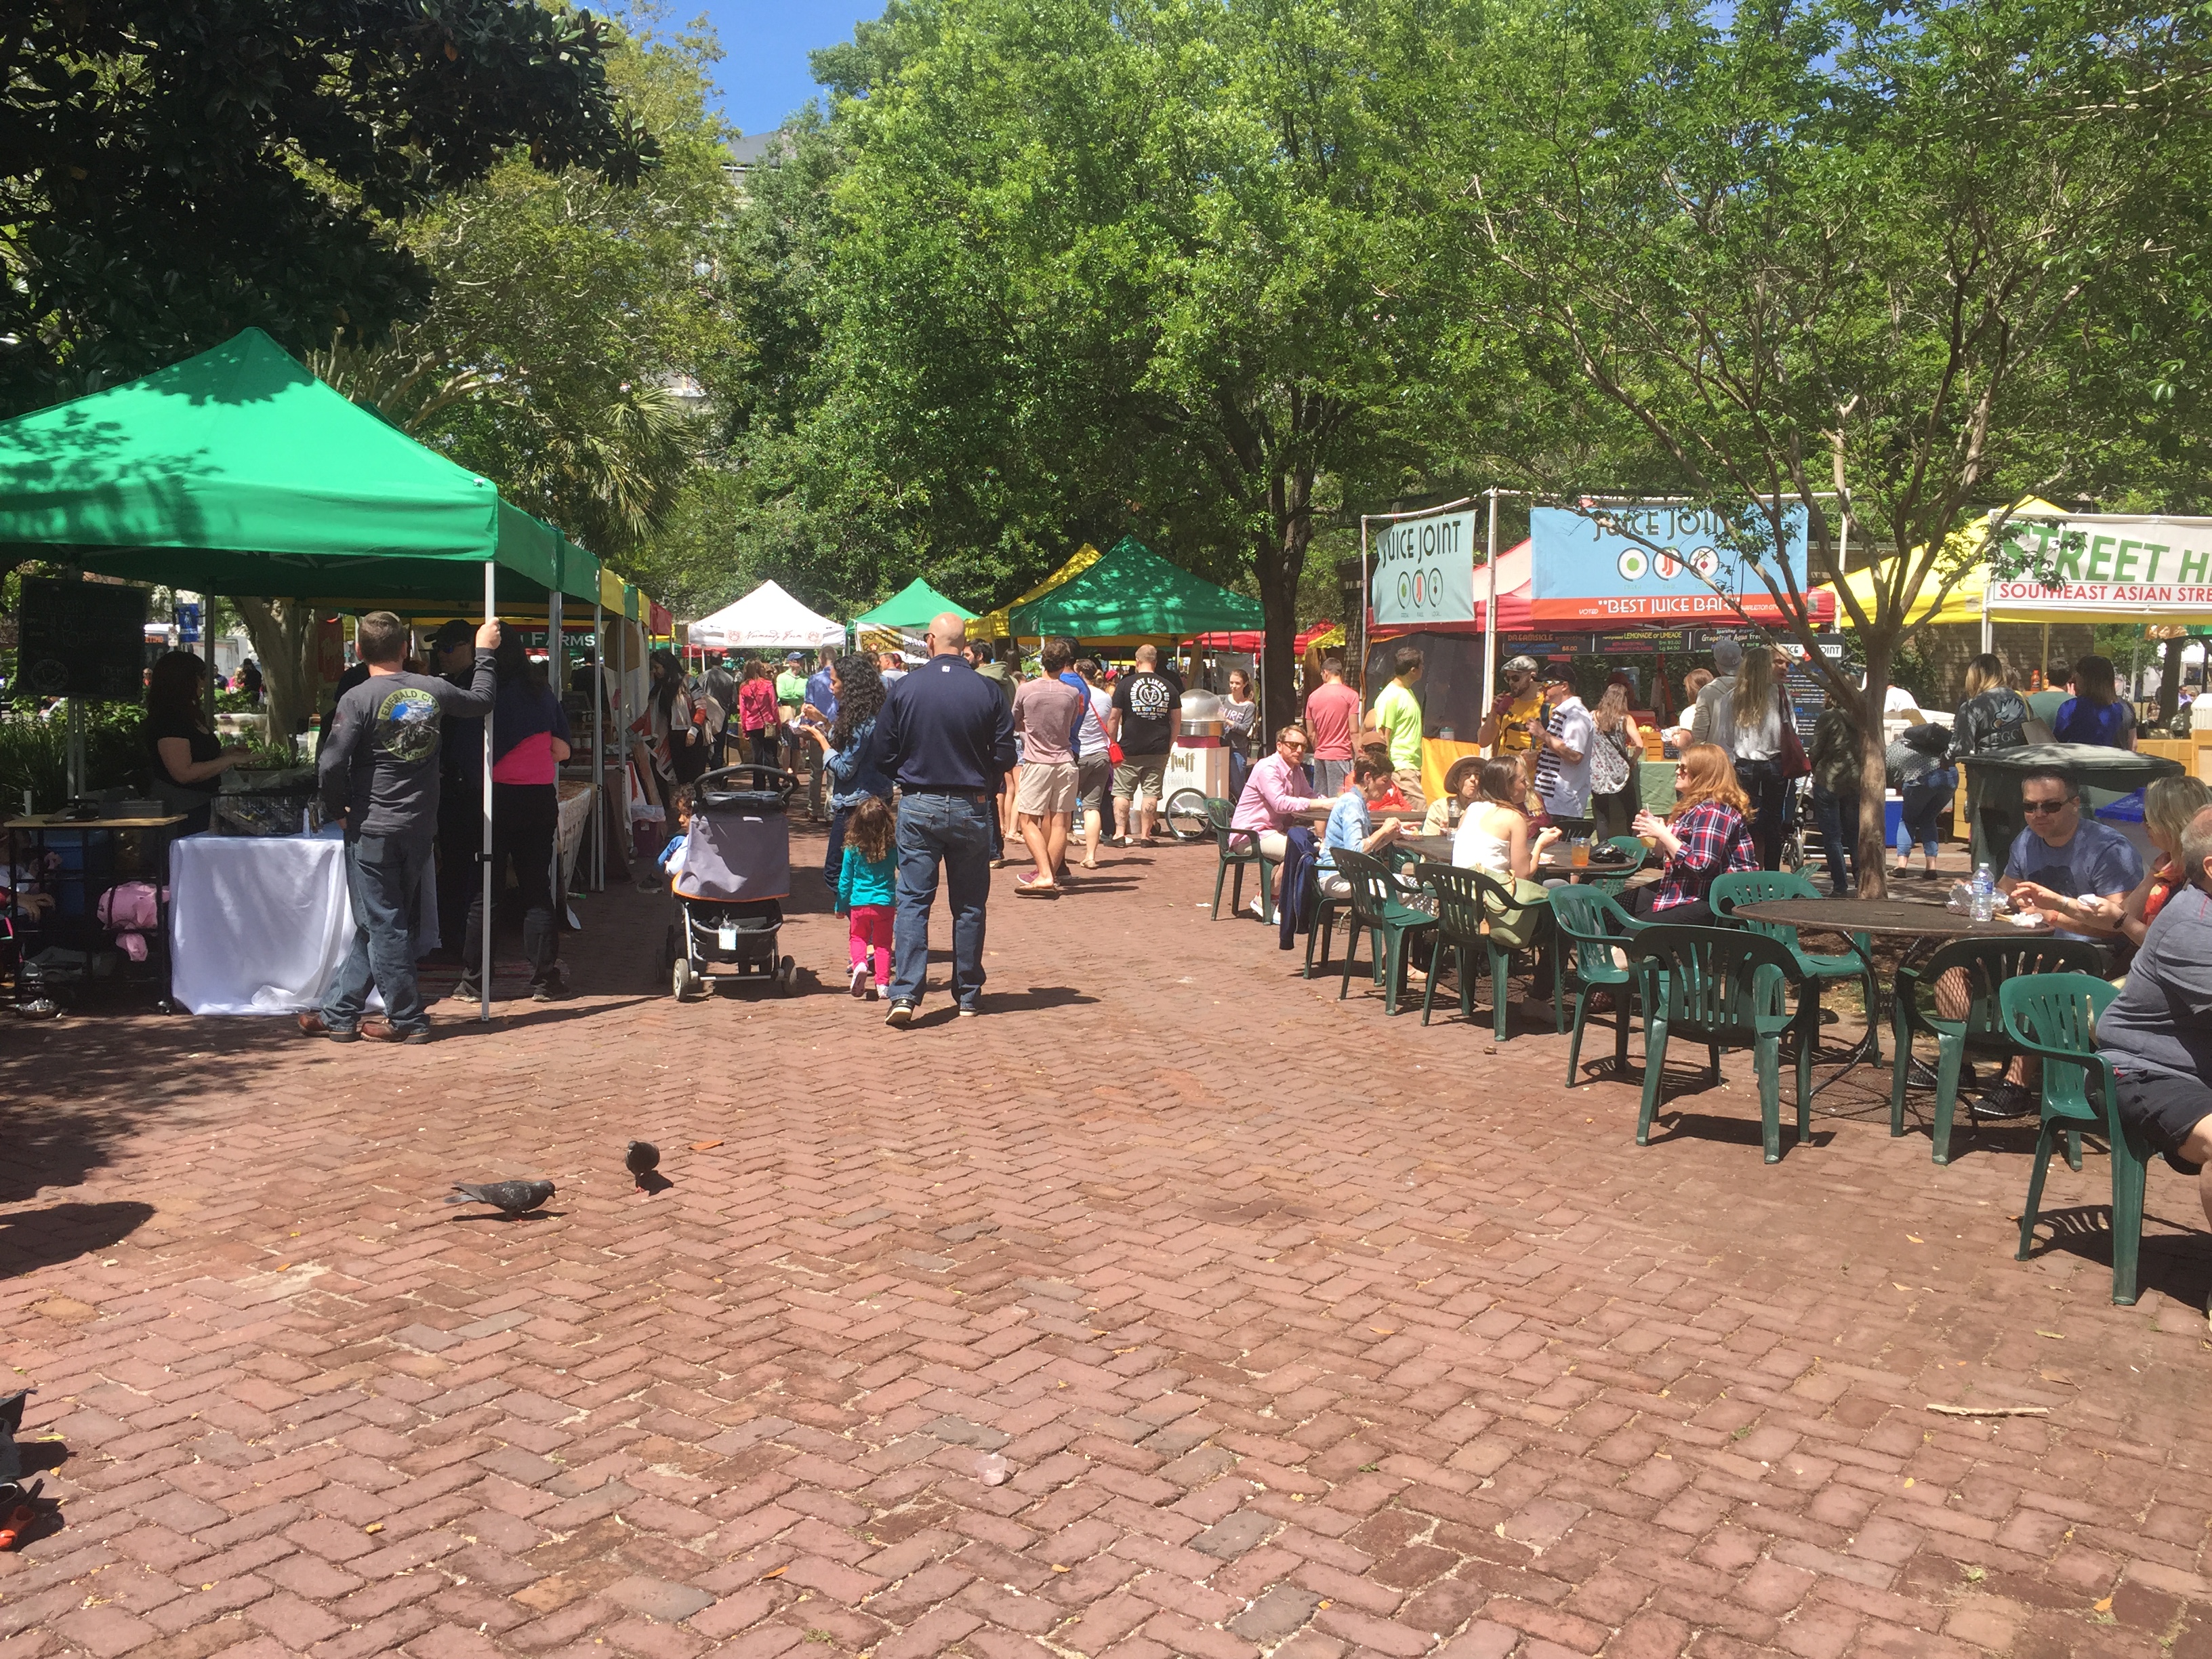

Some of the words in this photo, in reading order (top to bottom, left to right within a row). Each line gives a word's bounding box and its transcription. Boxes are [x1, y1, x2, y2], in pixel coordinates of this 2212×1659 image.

[1418, 520, 1461, 565] JOINT
[2002, 521, 2171, 583] STREET
[2177, 549, 2212, 583] H
[1999, 583, 2108, 600] SOUTHEAST
[2113, 586, 2171, 601] ASIAN
[1652, 598, 1689, 615] JUICE
[1507, 633, 1553, 641] DREAMSICLE
[1820, 646, 1840, 654] OINT
[1130, 677, 1145, 701] NOBODY
[1147, 677, 1167, 692] LIKES
[381, 690, 417, 717] EMERALD
[422, 693, 439, 710] CITY
[1994, 729, 2022, 743] FGC
[1170, 752, 1195, 773] fluff
